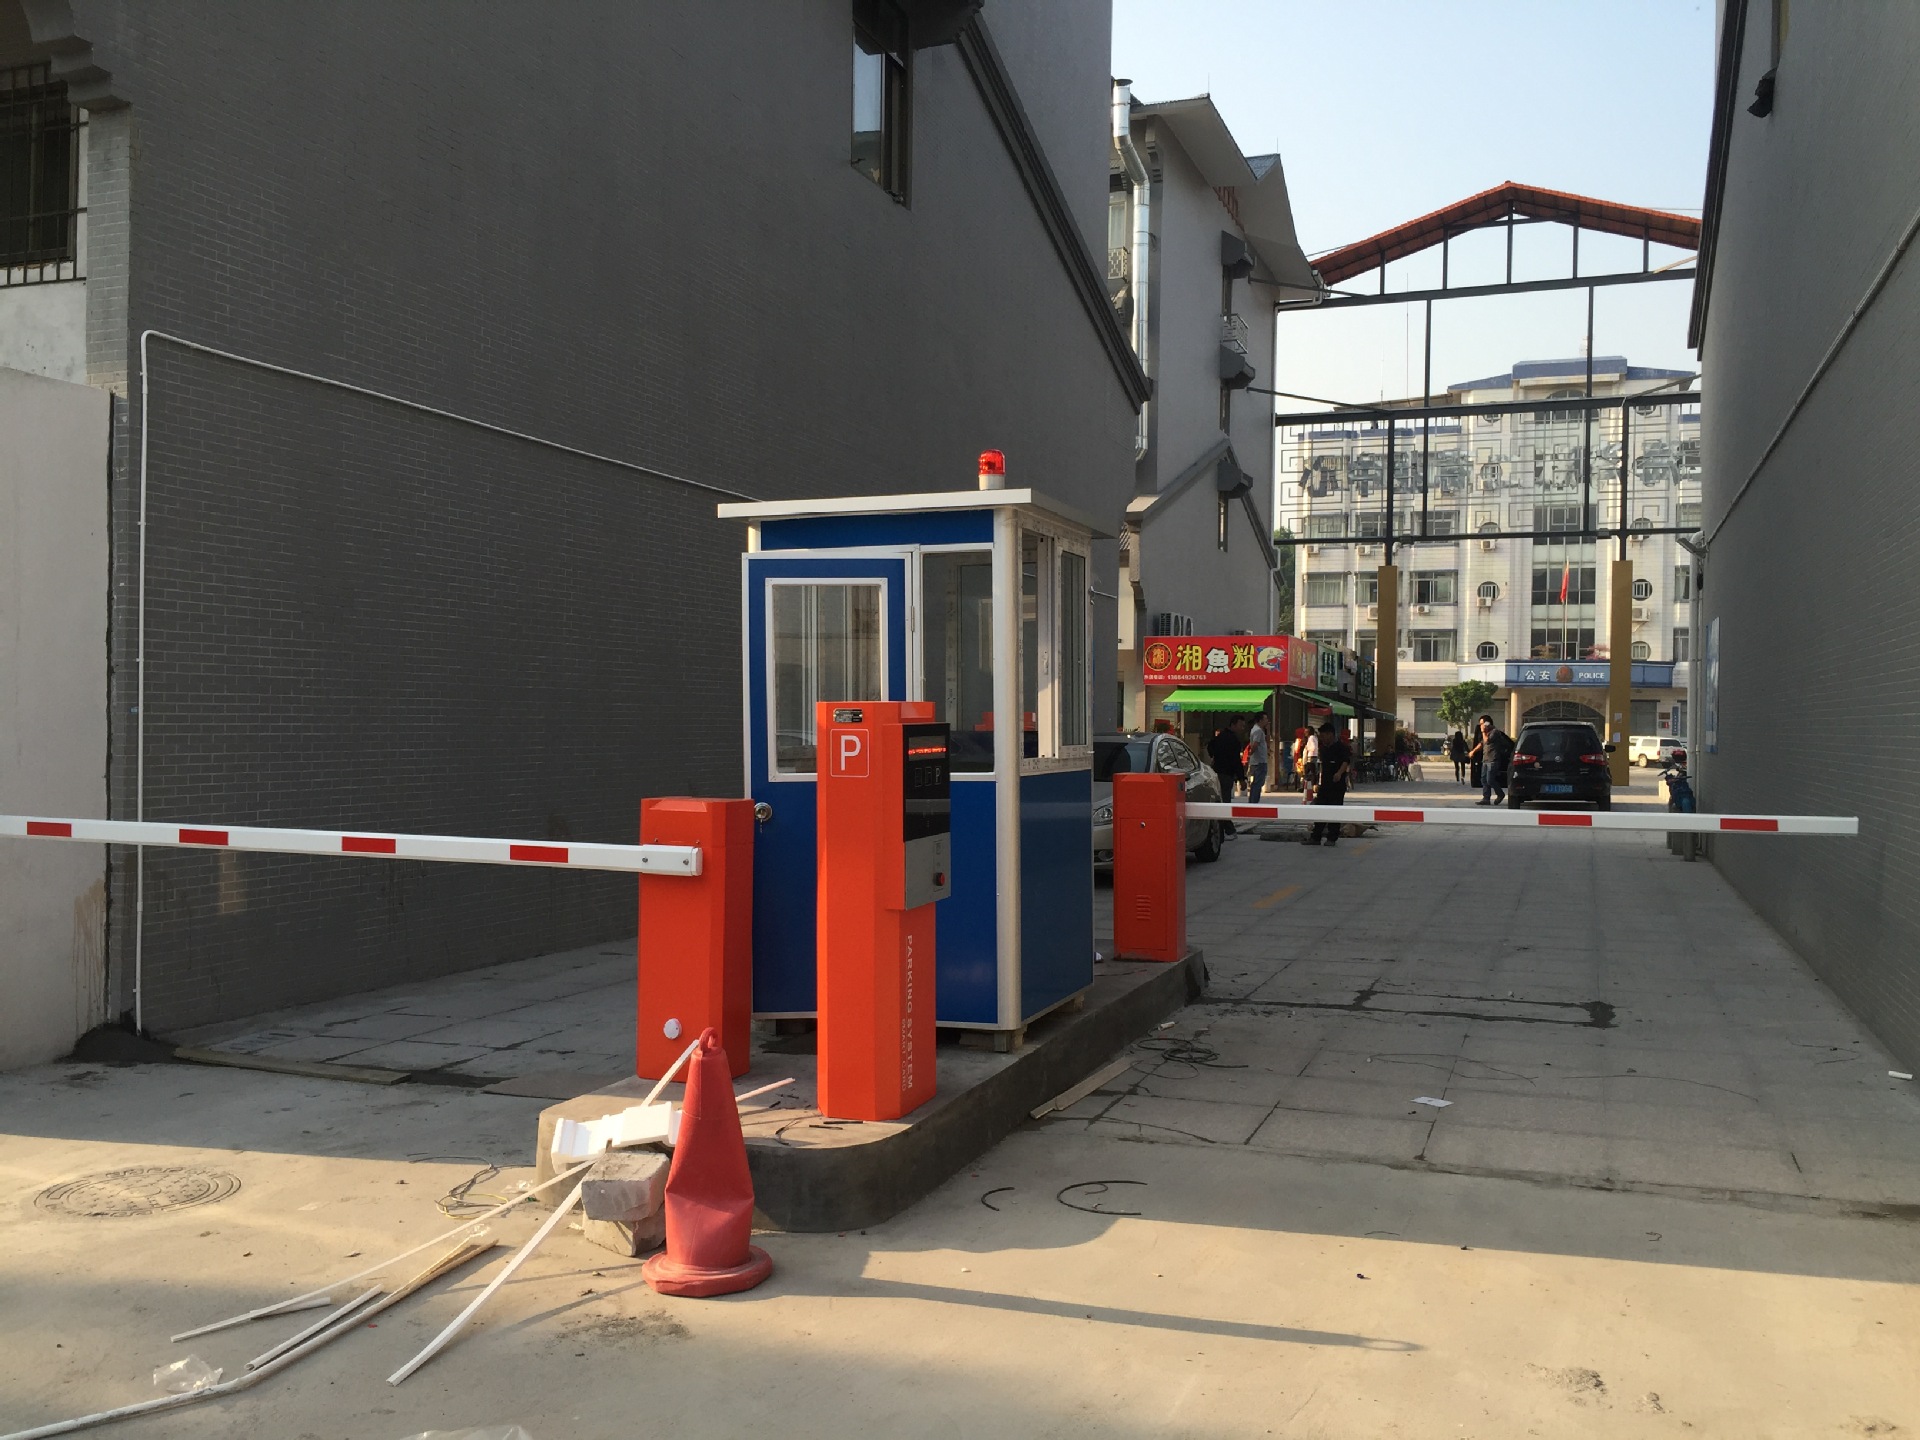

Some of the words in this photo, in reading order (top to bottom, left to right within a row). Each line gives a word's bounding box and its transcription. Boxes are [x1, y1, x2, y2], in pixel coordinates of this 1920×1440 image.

[1175, 643, 1256, 673] 湘魚粉
[1525, 670, 1550, 681] 公安
[840, 735, 862, 771] P
